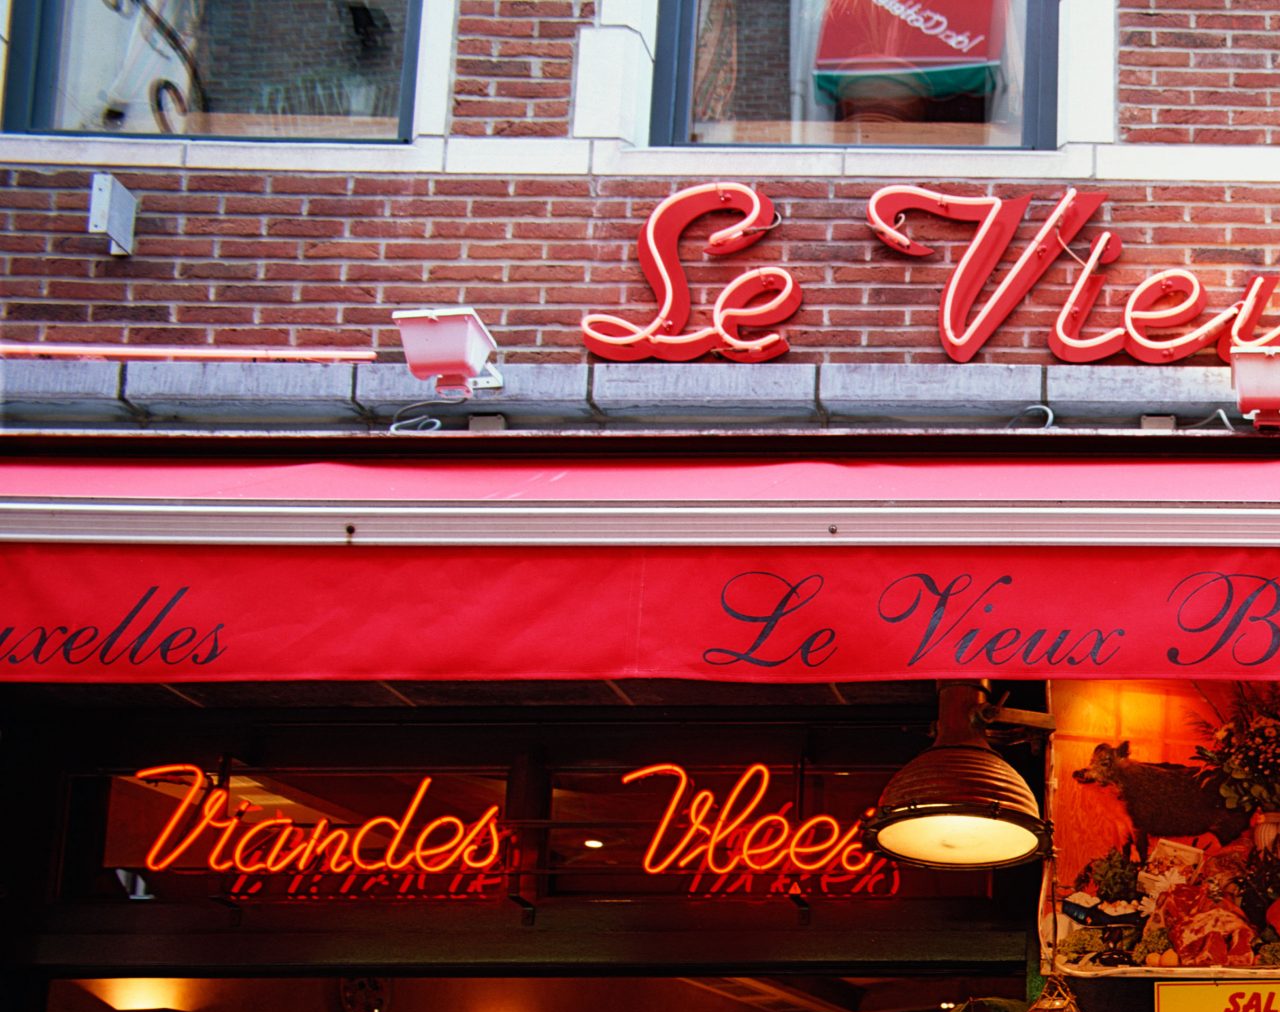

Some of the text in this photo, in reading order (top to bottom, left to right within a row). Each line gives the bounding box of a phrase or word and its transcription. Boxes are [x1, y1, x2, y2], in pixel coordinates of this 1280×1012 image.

[582, 182, 802, 362] Le
[703, 571, 837, 668] Le
[878, 573, 1125, 667] Vieux
[135, 763, 500, 873] Viandes
